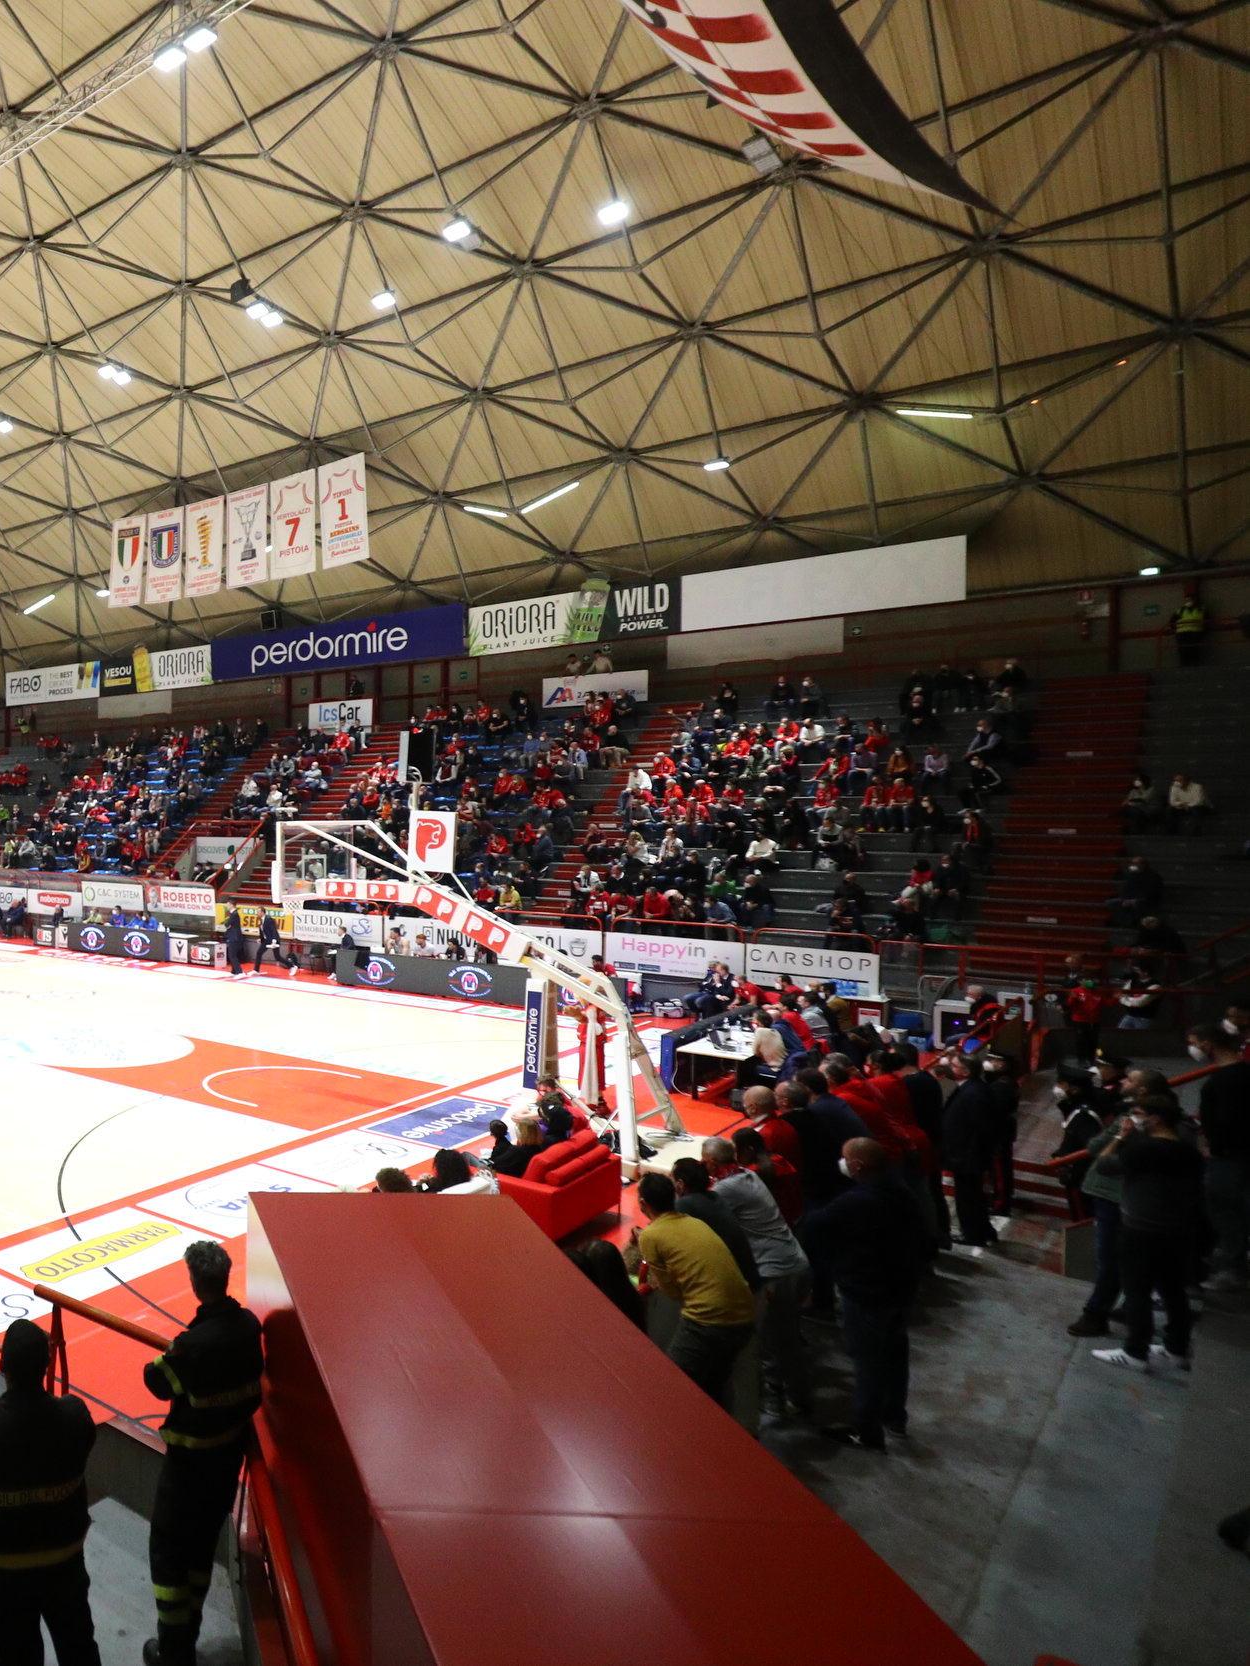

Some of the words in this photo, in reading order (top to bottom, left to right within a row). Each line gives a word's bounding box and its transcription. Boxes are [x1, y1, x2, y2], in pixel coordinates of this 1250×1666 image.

[338, 499, 348, 520] 1
[285, 517, 300, 546] 7
[279, 545, 309, 558] PISTOIA
[614, 583, 670, 618] WILD
[619, 619, 664, 632] POWER
[251, 622, 408, 672] perdormire
[483, 639, 517, 651] PLANT
[522, 635, 556, 647] JUICE
[60, 671, 73, 679] BEST
[104, 665, 132, 679] VESOU
[48, 687, 73, 697] PROCESS
[318, 703, 360, 722] IcsCar
[114, 888, 140, 899] SYSTEM
[163, 892, 212, 904] ROBERTO
[296, 914, 343, 926] STUDIO
[296, 925, 338, 935] IMMOBILIAR
[622, 937, 706, 959] Happyin
[750, 948, 872, 971] CARSHOP
[526, 1008, 539, 1073] perdormire
[36, 1224, 169, 1278] PARMACOTTO
